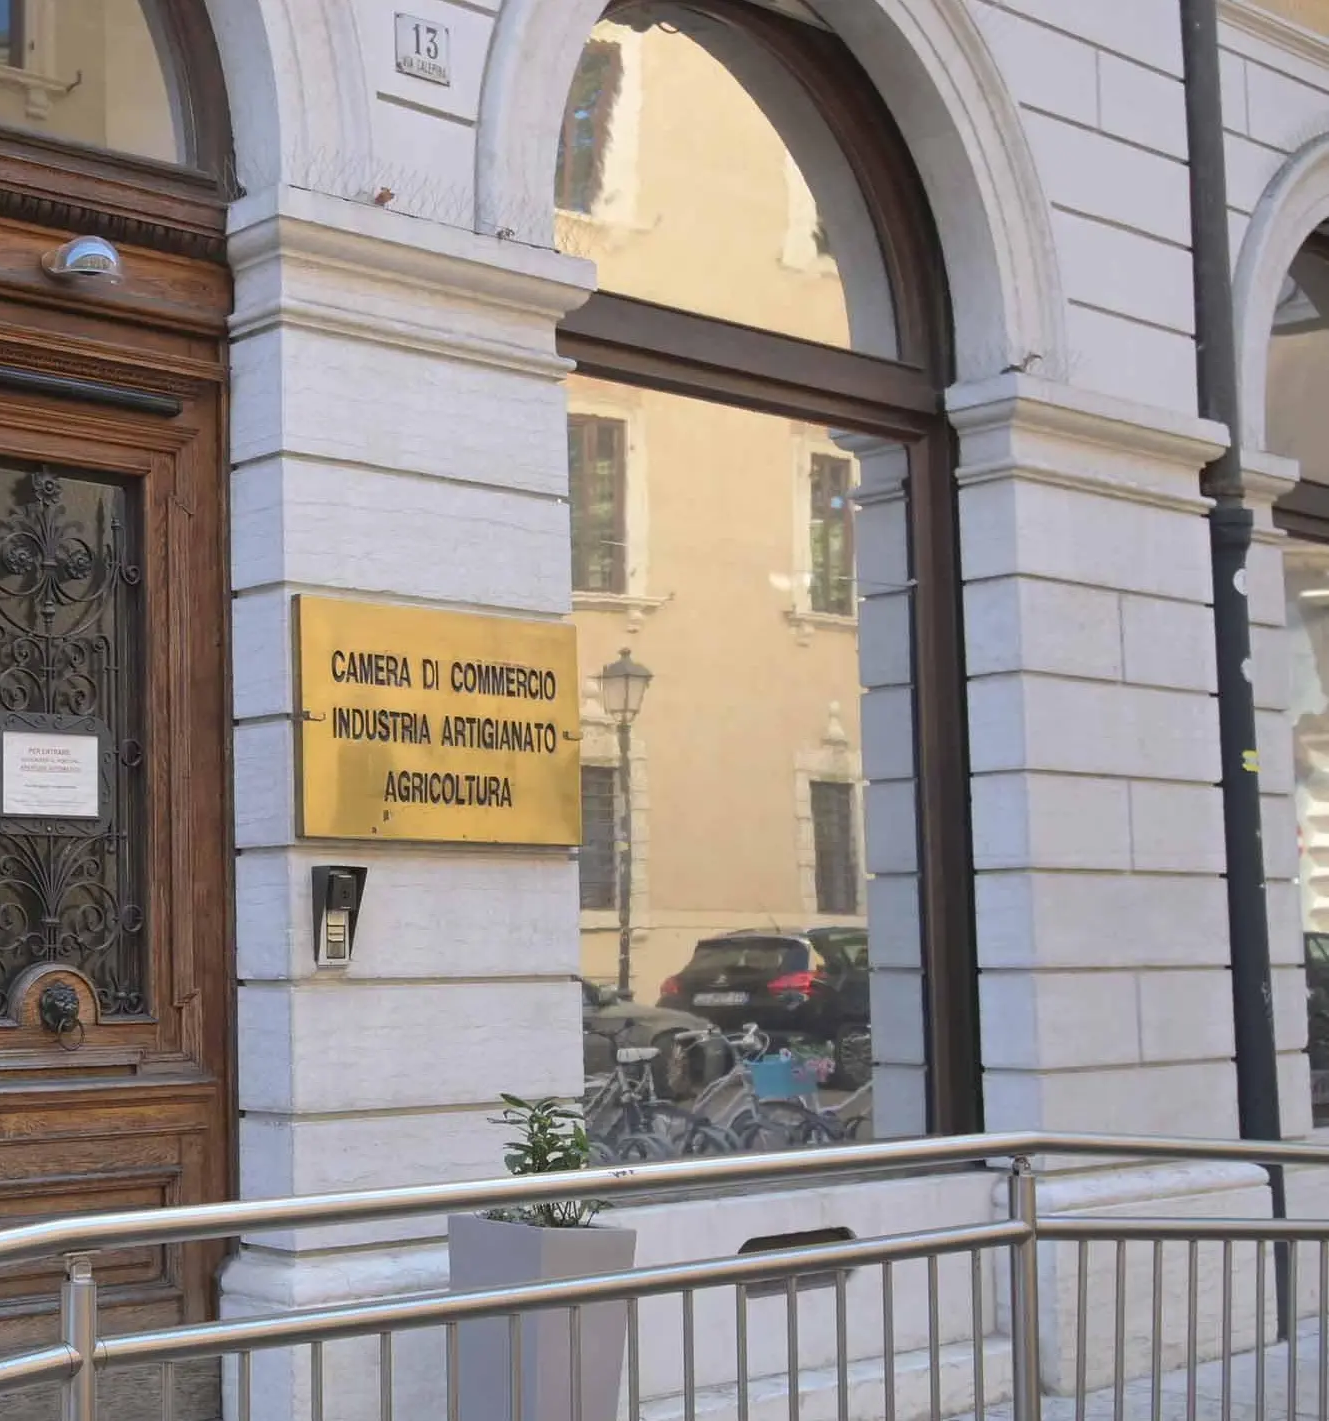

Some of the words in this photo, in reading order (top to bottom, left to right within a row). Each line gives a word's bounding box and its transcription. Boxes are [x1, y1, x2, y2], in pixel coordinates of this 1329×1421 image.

[413, 23, 438, 60] 13
[331, 649, 411, 688] CAMERA
[422, 658, 439, 690] DI
[450, 661, 556, 701] COMMERCIO
[332, 707, 431, 744] INDUSTRIA
[441, 715, 557, 754] ARTIGIANATO
[384, 770, 512, 807] AGRICOLTURA
